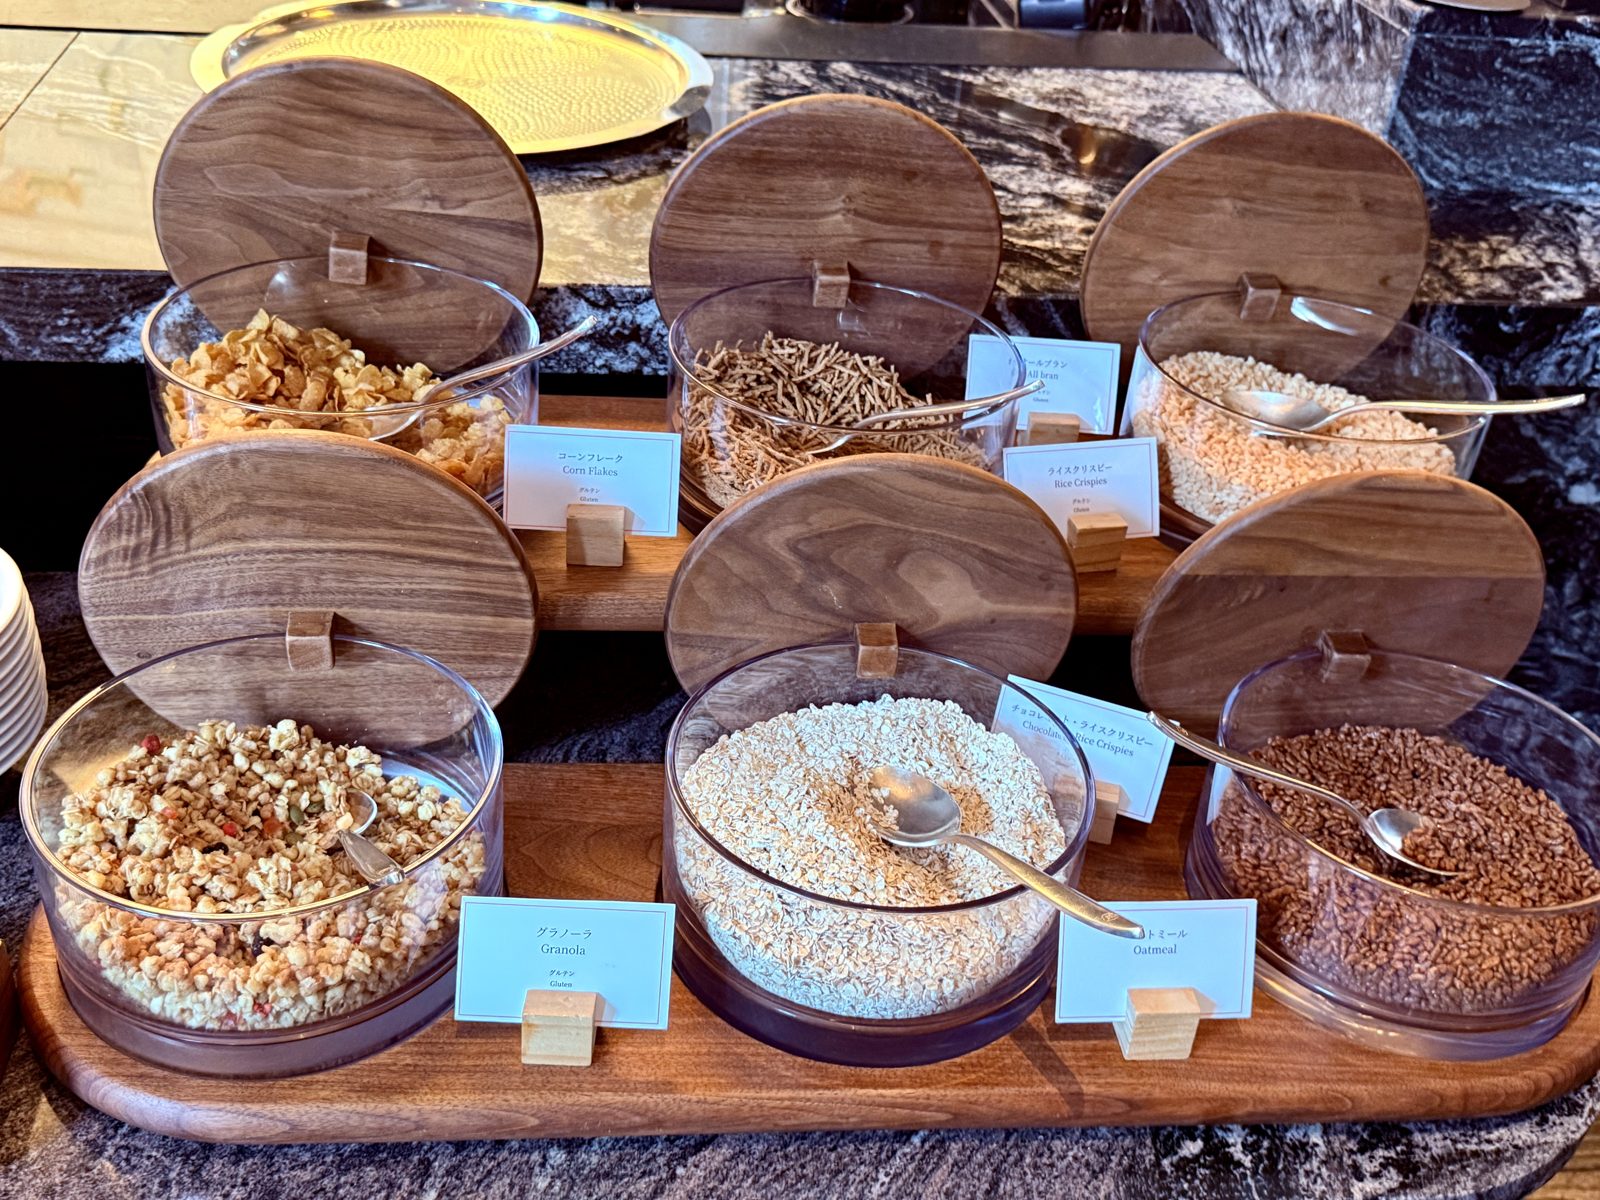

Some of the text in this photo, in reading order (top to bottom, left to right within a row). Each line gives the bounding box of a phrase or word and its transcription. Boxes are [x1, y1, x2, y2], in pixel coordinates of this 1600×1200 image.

[1028, 370, 1059, 380] All bran
[558, 452, 624, 464] コーンフレーク
[562, 465, 619, 477] Corn Flakes
[1048, 463, 1113, 476] ライスクリスピー
[1054, 476, 1108, 489] Rice Crispies
[1075, 732, 1095, 746] Rice
[1096, 738, 1134, 757] Crispies
[536, 926, 593, 940] グラノーラ
[540, 943, 586, 956] Granola
[1133, 944, 1177, 955] Oatmeal
[549, 969, 575, 977] グルテン
[549, 980, 573, 988] Gluten
